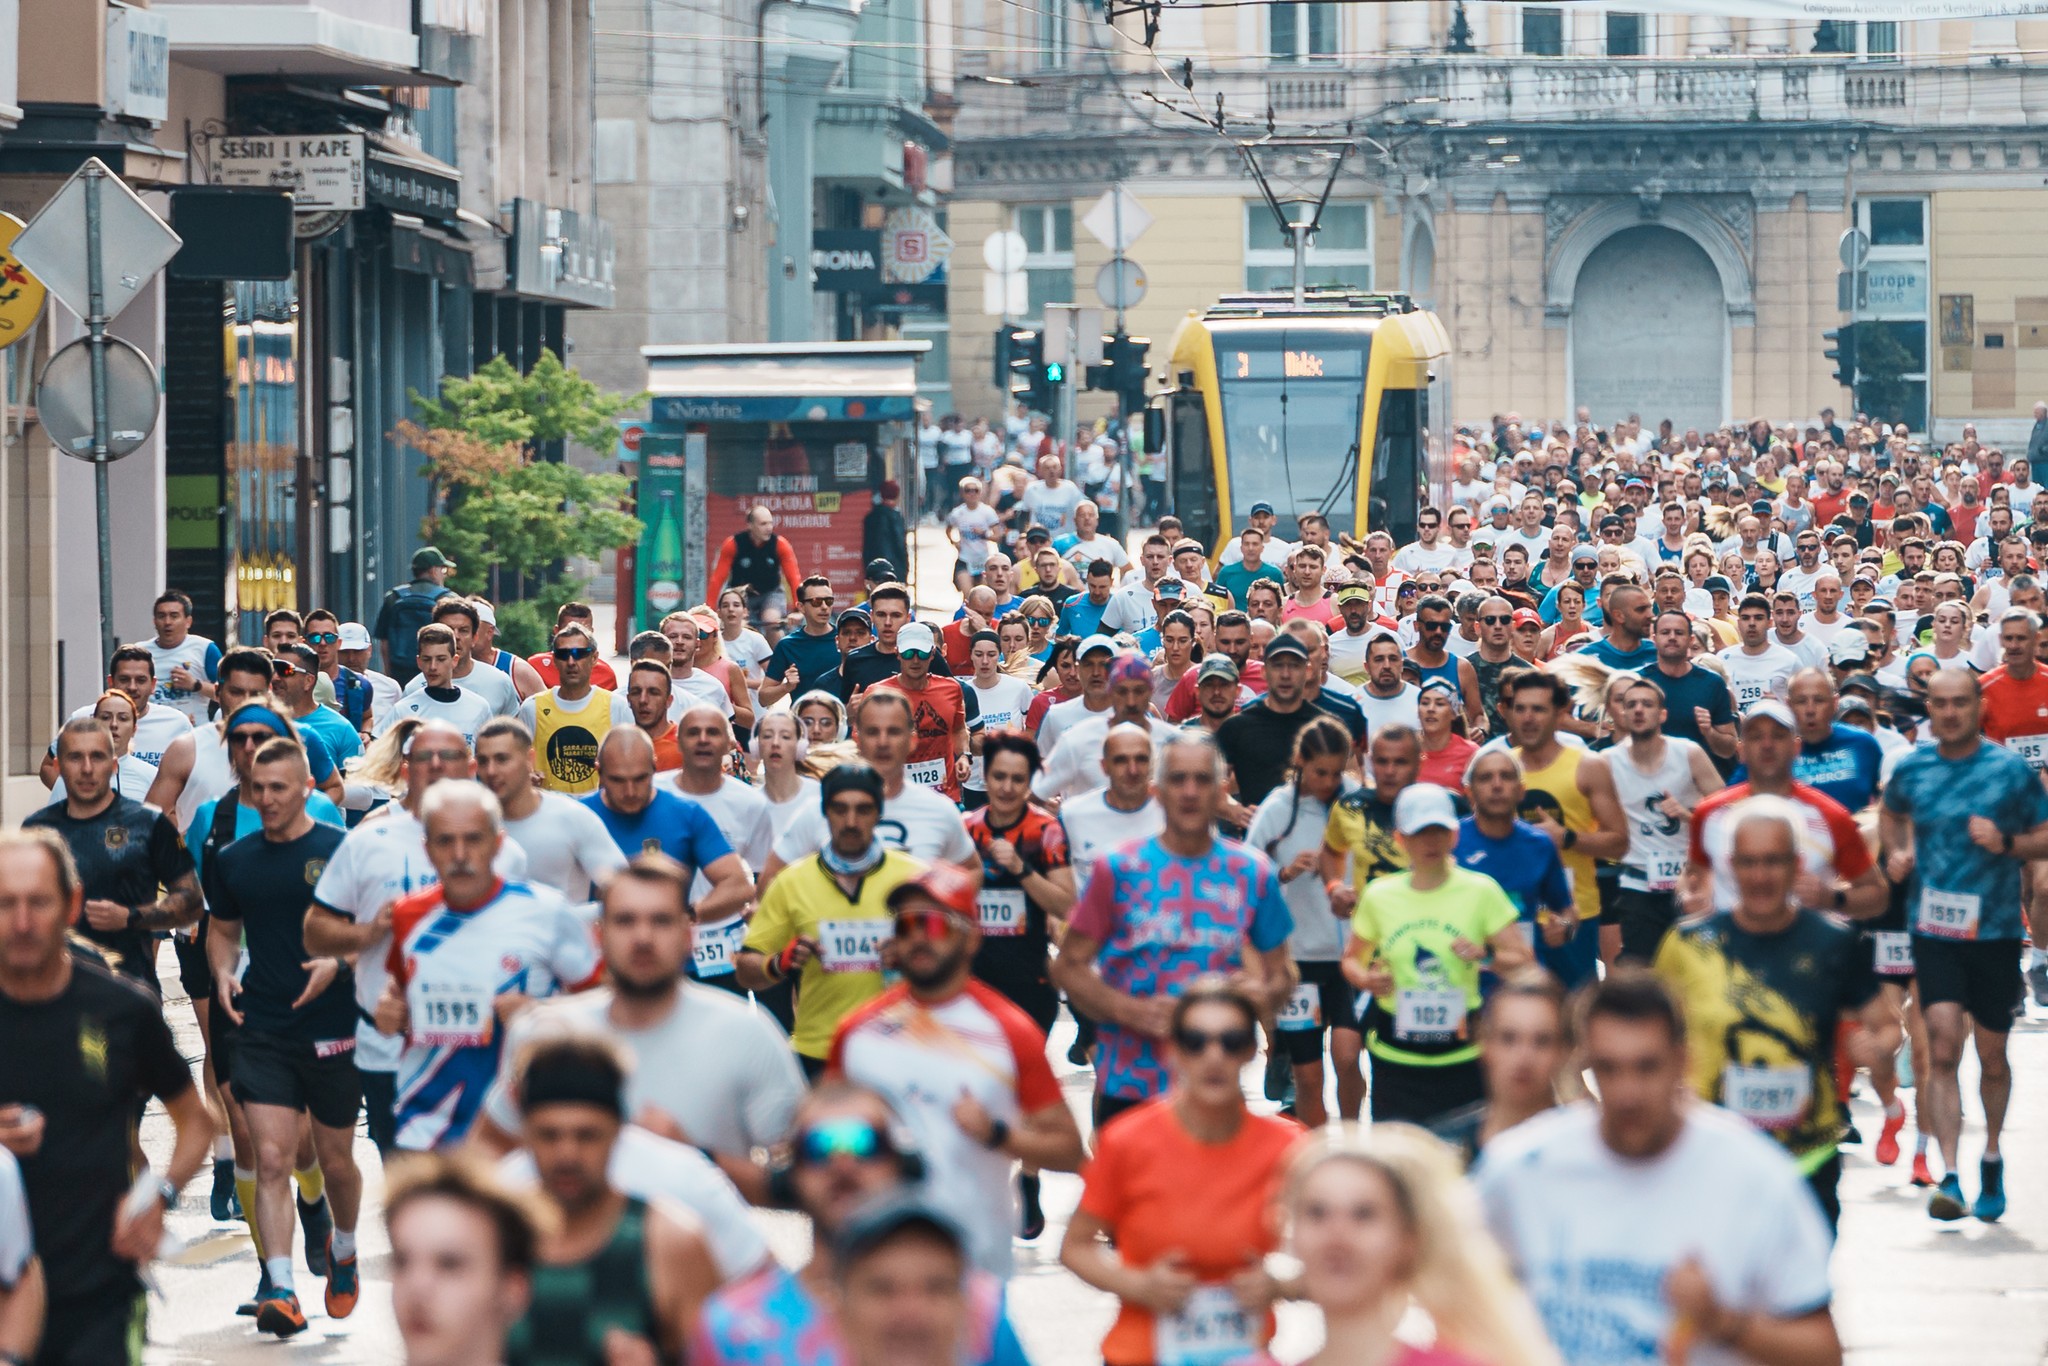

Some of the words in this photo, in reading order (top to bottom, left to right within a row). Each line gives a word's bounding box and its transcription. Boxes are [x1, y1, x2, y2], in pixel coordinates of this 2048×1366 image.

[220, 138, 274, 159] ŠEŠIRI
[284, 141, 290, 158] I
[301, 140, 351, 157] KAPE
[1869, 275, 1916, 290] urope
[1869, 290, 1904, 304] ouse
[1741, 687, 1761, 699] 258
[912, 770, 939, 783] 1128
[1658, 862, 1687, 876] 126
[1930, 904, 1967, 923] 1557
[1886, 946, 1912, 961] 157
[426, 1002, 479, 1025] 1595
[1413, 1006, 1448, 1025] 102
